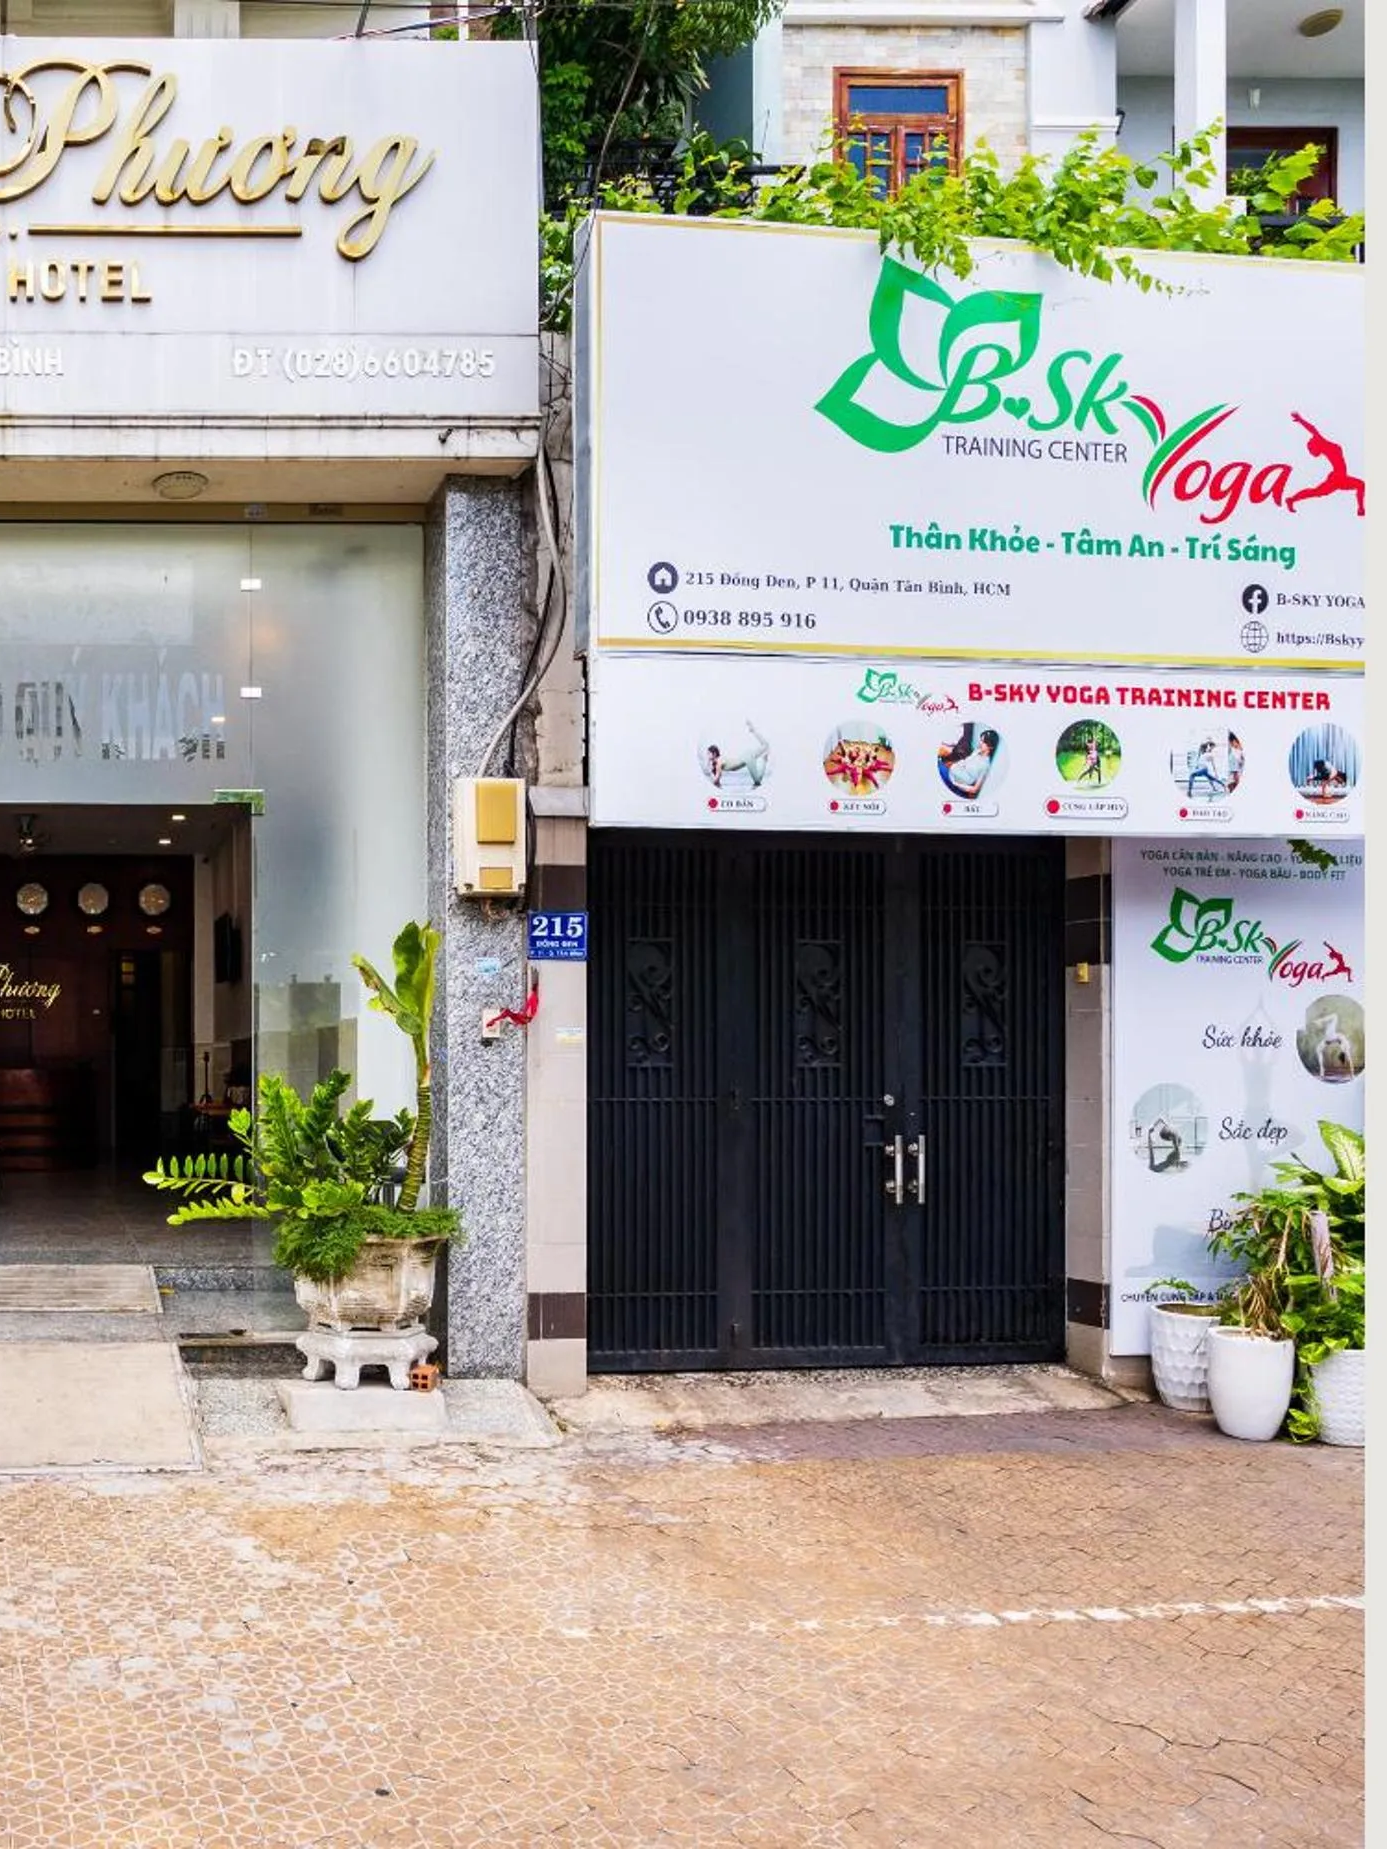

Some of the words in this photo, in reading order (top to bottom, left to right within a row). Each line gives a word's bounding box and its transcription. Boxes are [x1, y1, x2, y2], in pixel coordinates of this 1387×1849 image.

[9, 259, 154, 303] HOTEL
[942, 435, 1042, 460] TRAINING
[1049, 440, 1128, 464] CENTER
[889, 521, 962, 550] Thân
[968, 525, 1041, 553] Khỏe
[1061, 528, 1122, 555] Tâm
[1128, 534, 1165, 557] An
[1185, 532, 1222, 560] Trí
[1227, 534, 1296, 570] Sáng
[685, 572, 715, 586] 215
[806, 576, 816, 589] P
[849, 578, 889, 594] Quận
[893, 579, 923, 593] Tân
[973, 582, 1011, 596] HCM
[1277, 593, 1322, 607] B-SKY
[683, 609, 732, 626] 0938
[738, 611, 774, 628] 895
[780, 613, 817, 629] 916
[968, 683, 1041, 703] B-SKY
[1046, 685, 1110, 705] YOGA
[1115, 686, 1237, 709] TRAINING
[1243, 690, 1331, 711] CENTER
[1140, 849, 1170, 860] YOGA
[1163, 866, 1192, 877] YOGA
[1239, 867, 1268, 879] YOGA
[531, 916, 584, 938] 215
[1234, 955, 1264, 965] CENTER
